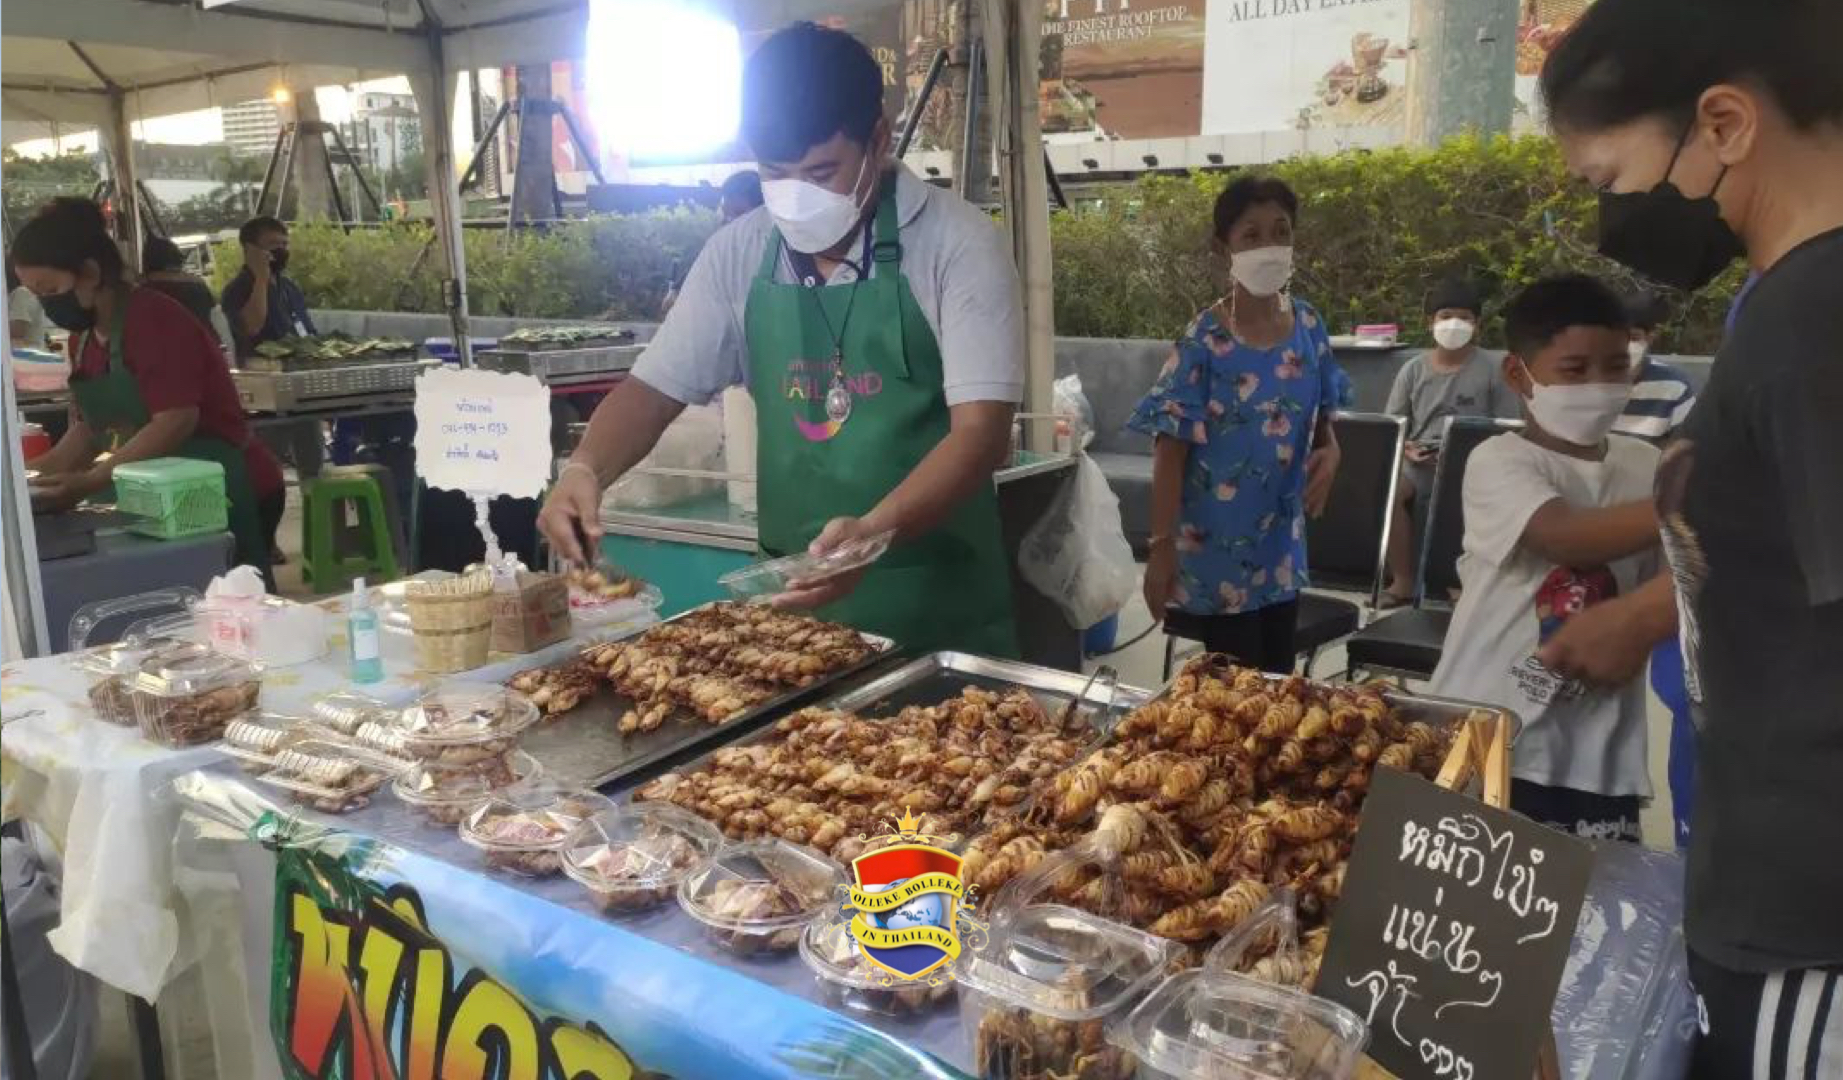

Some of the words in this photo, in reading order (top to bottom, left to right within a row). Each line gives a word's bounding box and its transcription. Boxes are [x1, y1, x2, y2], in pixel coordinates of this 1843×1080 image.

[1067, 15, 1115, 33] FINEST
[1117, 5, 1188, 29] ROOFTOP
[1229, 0, 1267, 22] ALL
[1063, 24, 1153, 48] RESTAURANT
